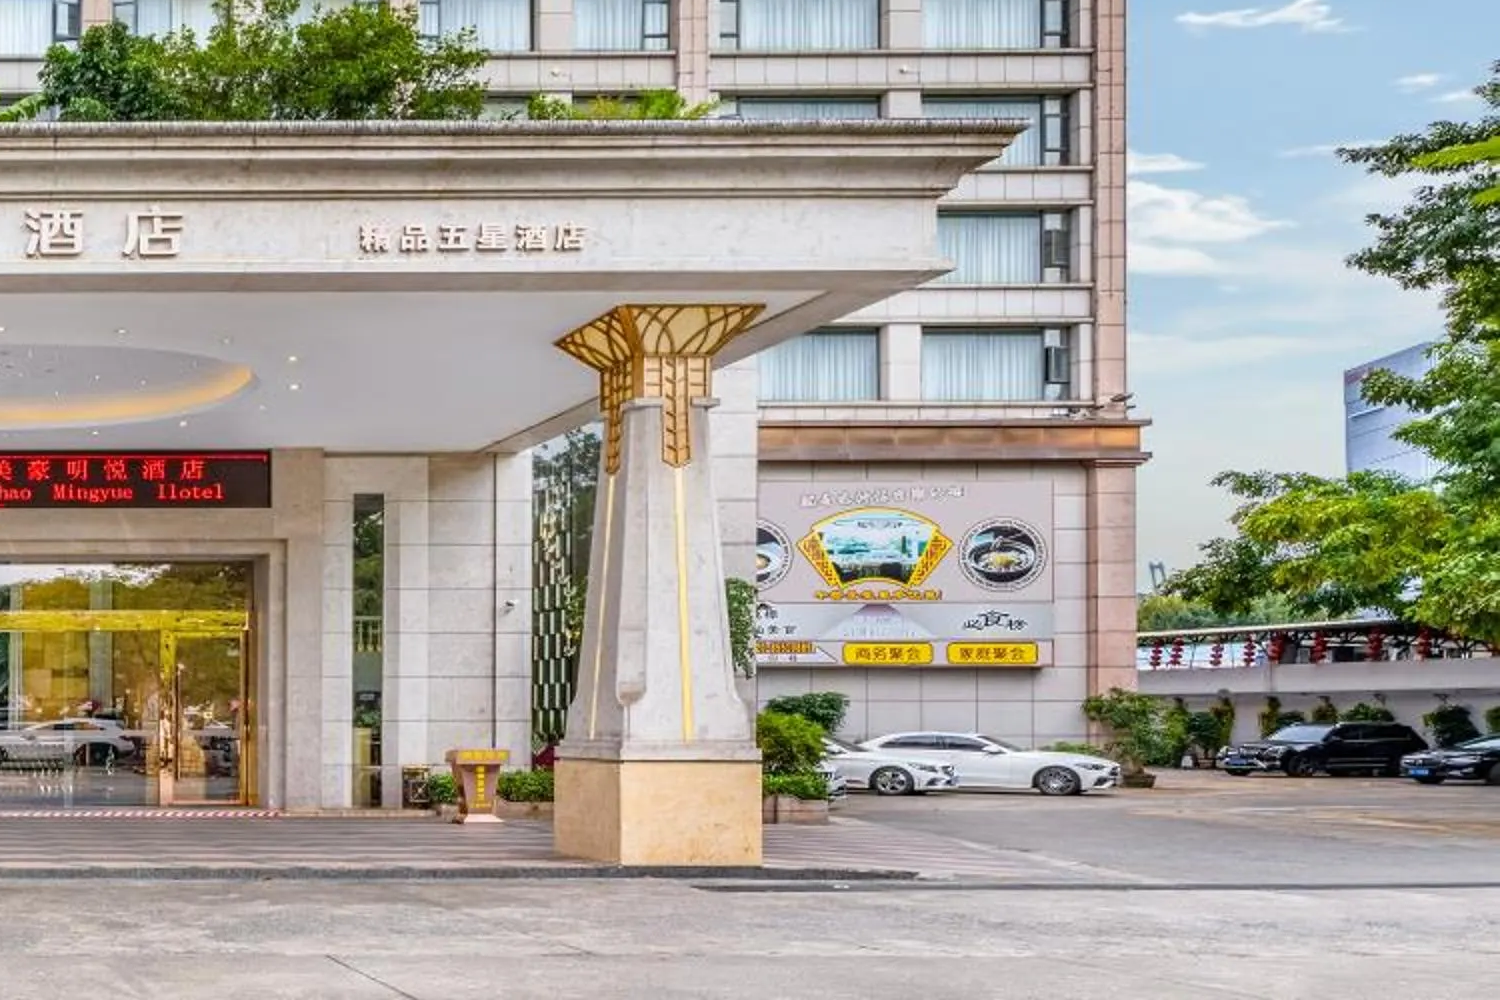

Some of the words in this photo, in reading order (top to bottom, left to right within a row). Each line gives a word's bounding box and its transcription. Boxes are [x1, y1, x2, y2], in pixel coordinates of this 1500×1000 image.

[357, 221, 588, 253] 精品五星酒店
[53, 484, 134, 503] Mingyue
